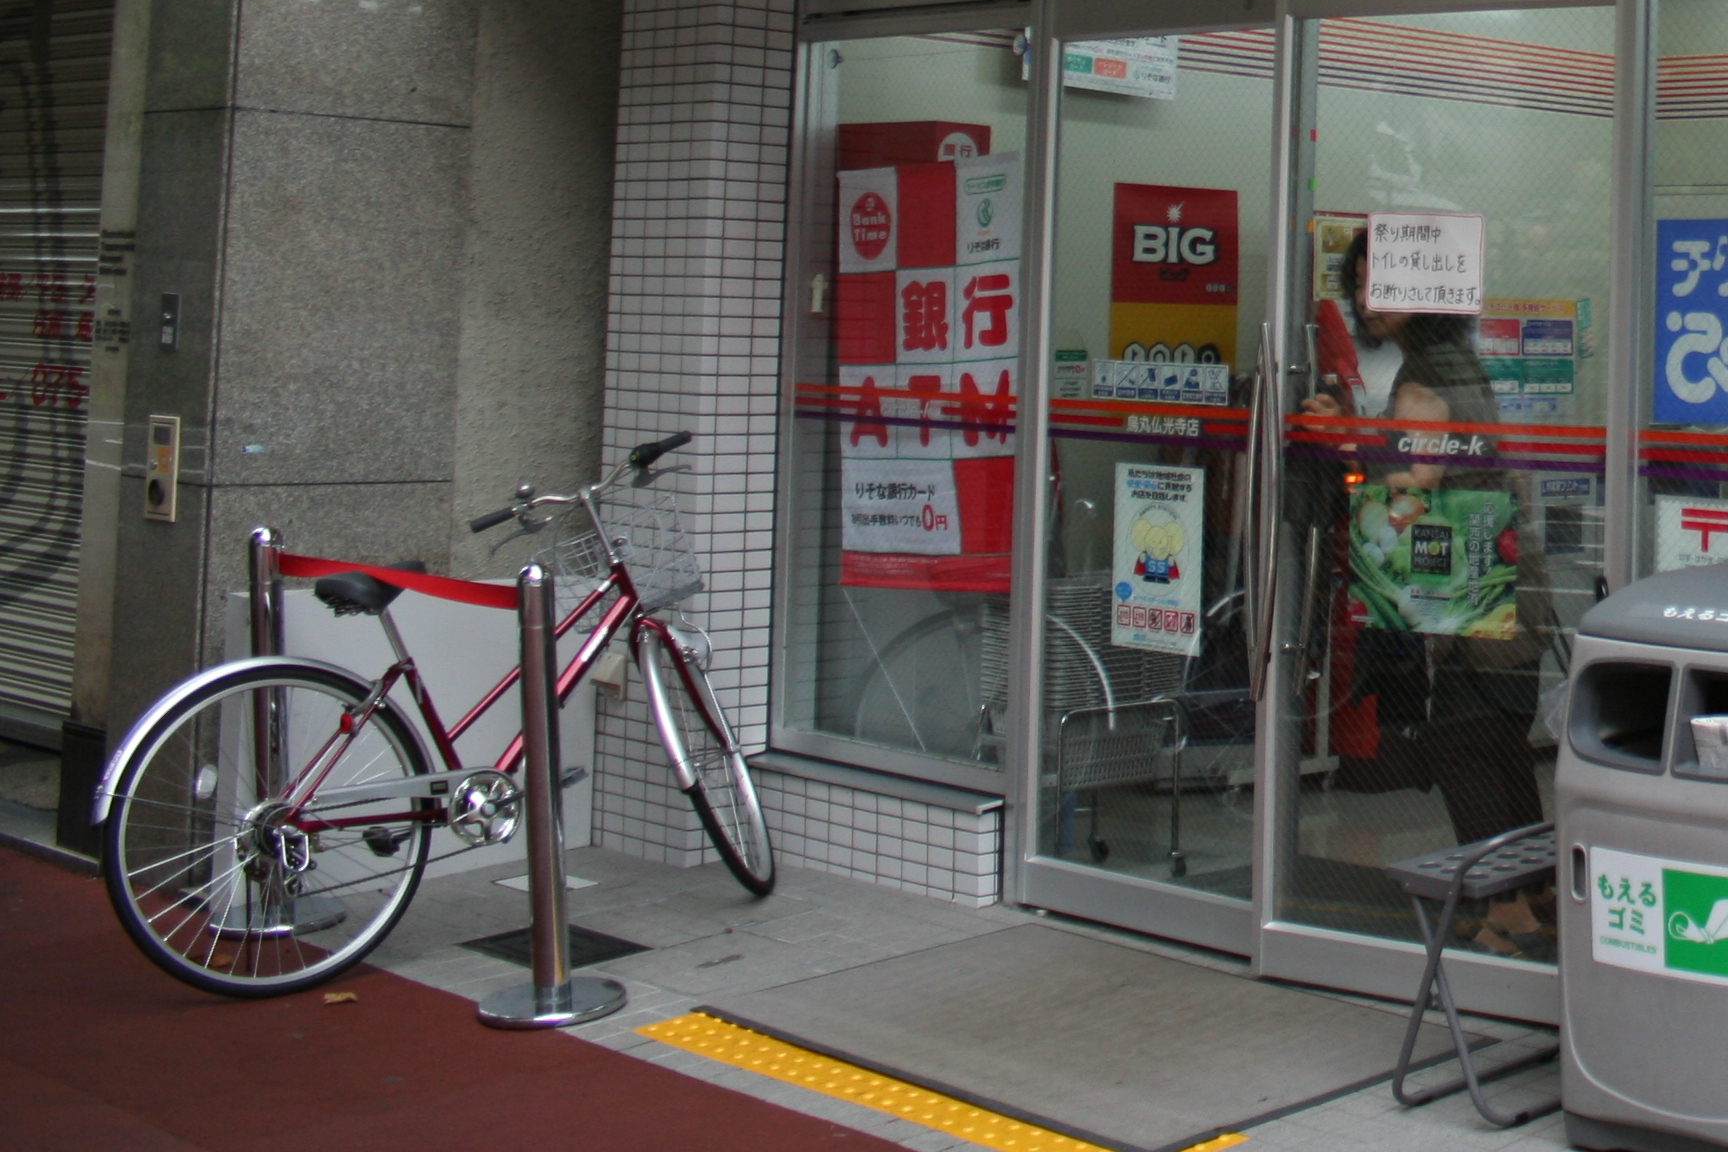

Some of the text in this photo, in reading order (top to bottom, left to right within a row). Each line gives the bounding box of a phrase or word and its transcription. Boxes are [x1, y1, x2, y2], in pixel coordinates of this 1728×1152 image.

[853, 213, 887, 227] Bank
[853, 228, 888, 242] Time
[1132, 224, 1217, 265] BIG
[1373, 223, 1442, 244] 祭り期間中
[1371, 251, 1467, 274] トイレの貸し出しを
[902, 273, 1013, 351] 銀行
[851, 369, 1010, 447] ATM
[1397, 432, 1485, 456] circle-k
[855, 482, 936, 503] りそな銀行カード
[1412, 528, 1450, 540] KANSAI
[1597, 874, 1658, 908] もえる
[1608, 908, 1646, 936] ゴミ
